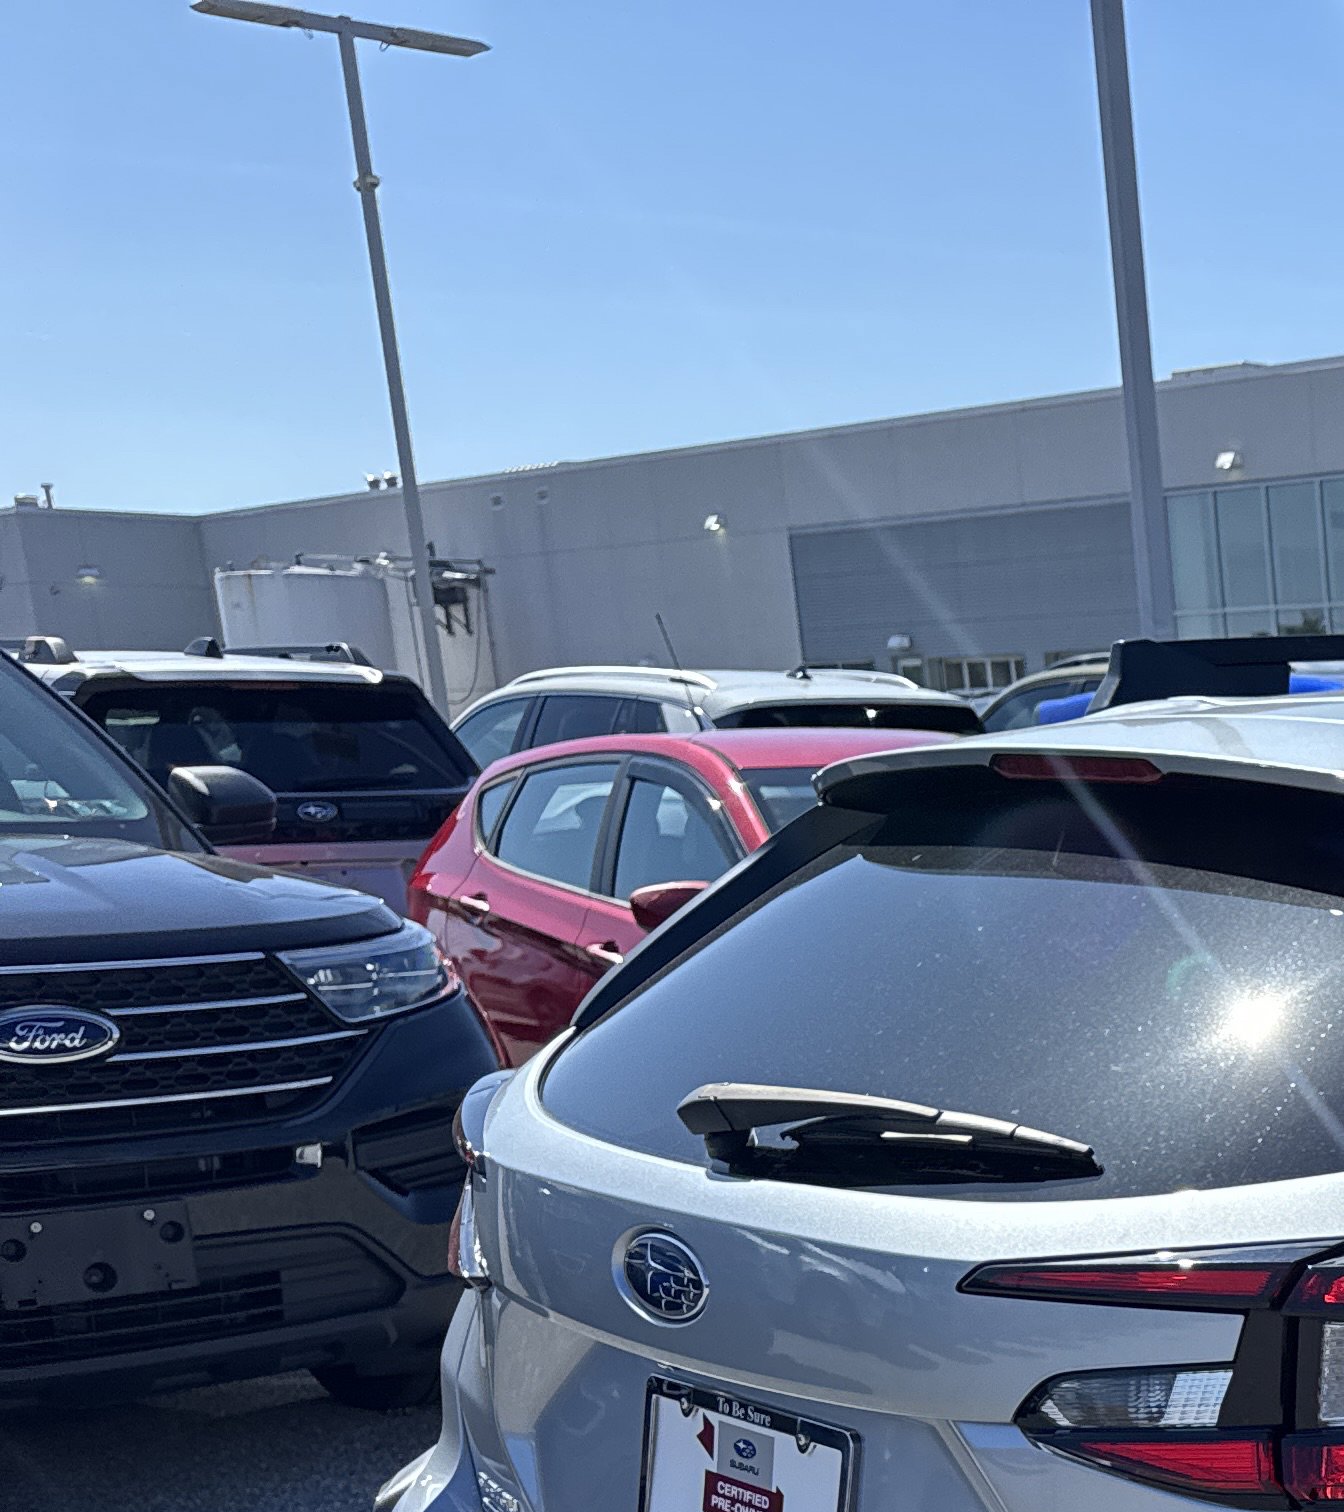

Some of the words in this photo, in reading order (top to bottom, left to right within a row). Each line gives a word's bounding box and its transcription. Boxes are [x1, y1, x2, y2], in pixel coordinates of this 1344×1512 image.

[8, 1020, 88, 1051] Ford
[717, 1396, 729, 1414] To
[732, 1401, 745, 1420] Be
[747, 1405, 772, 1427] Sure
[729, 1458, 760, 1476] SUBARU
[717, 1480, 770, 1510] CERTIFIED
